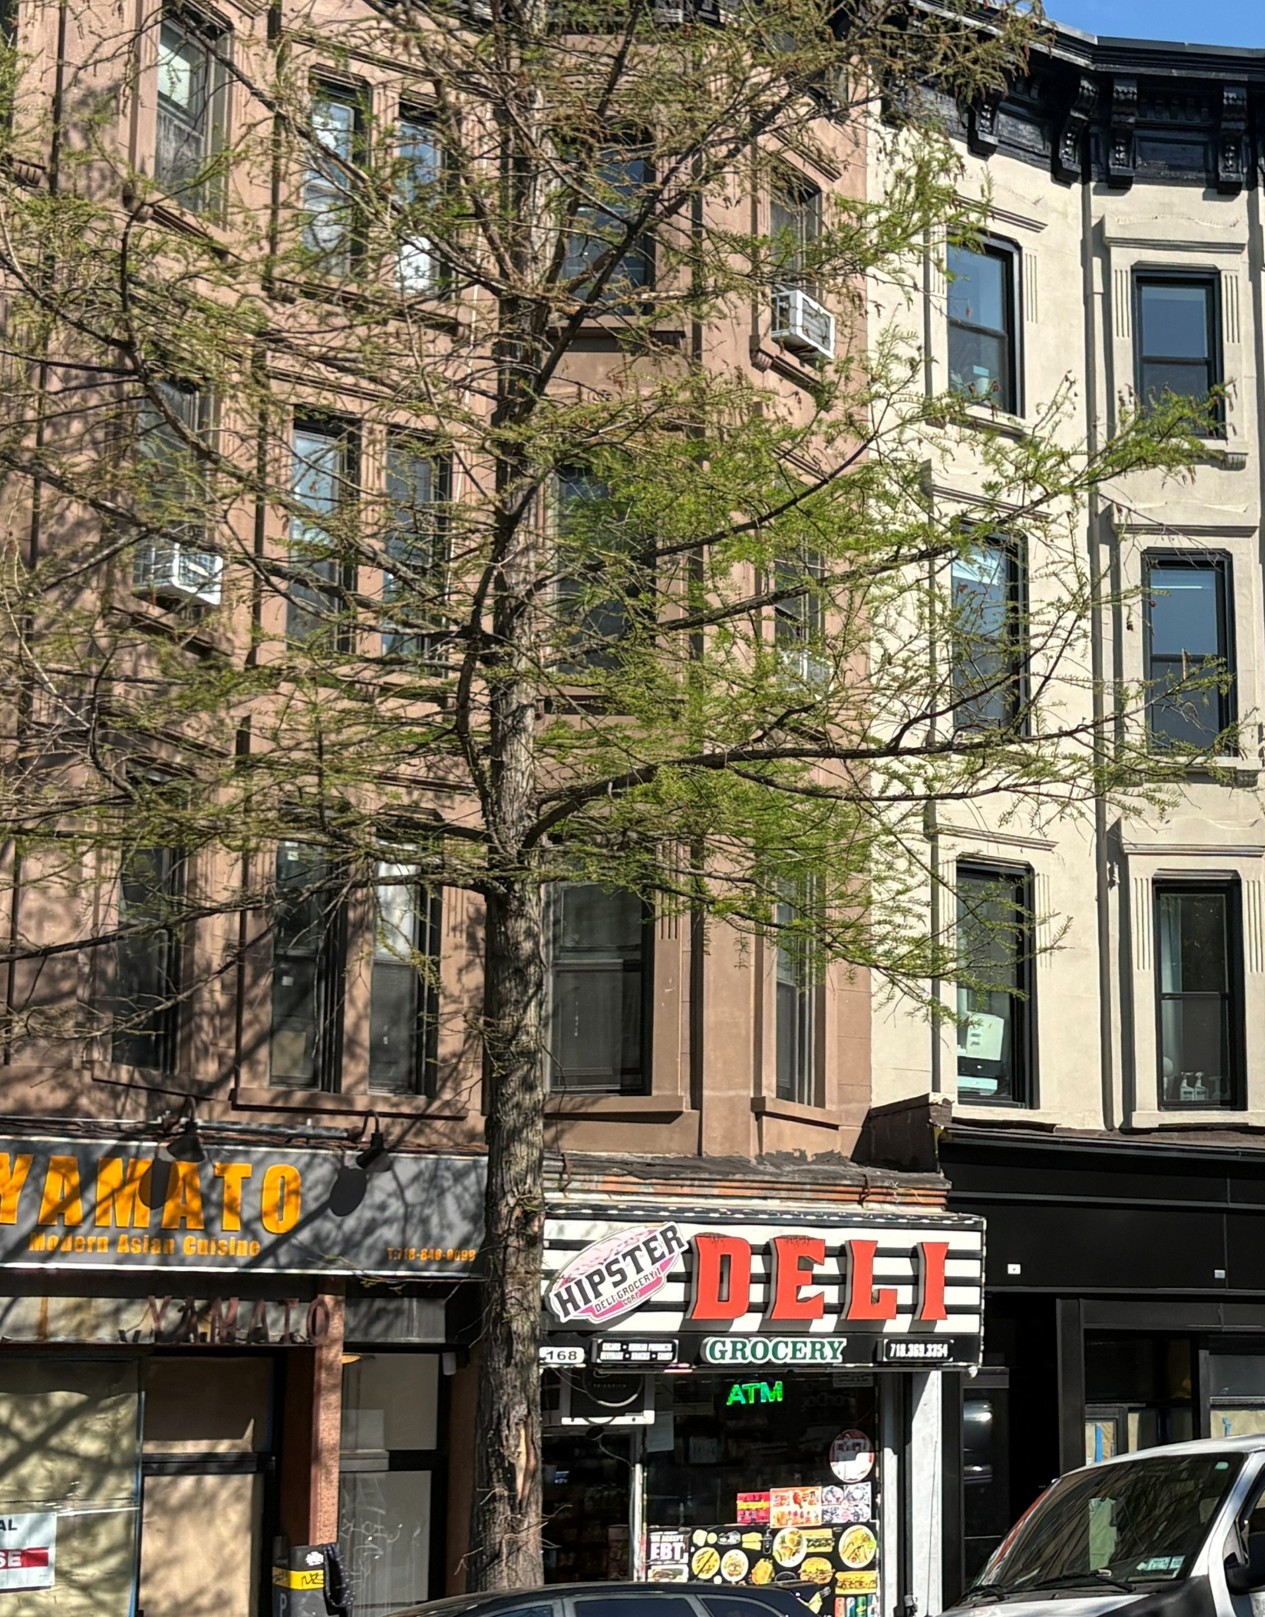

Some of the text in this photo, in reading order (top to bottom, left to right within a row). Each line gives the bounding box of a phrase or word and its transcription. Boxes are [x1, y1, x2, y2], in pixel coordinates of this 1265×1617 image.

[0, 1152, 301, 1235] YAMATO
[29, 1232, 261, 1257] Modern Asian Cuisine
[554, 1224, 685, 1318] HIPSTER
[690, 1232, 949, 1320] DELI
[546, 1350, 578, 1361] 168
[708, 1340, 843, 1361] GROCERY
[726, 1380, 783, 1405] ATM
[651, 1543, 685, 1560] EBT
